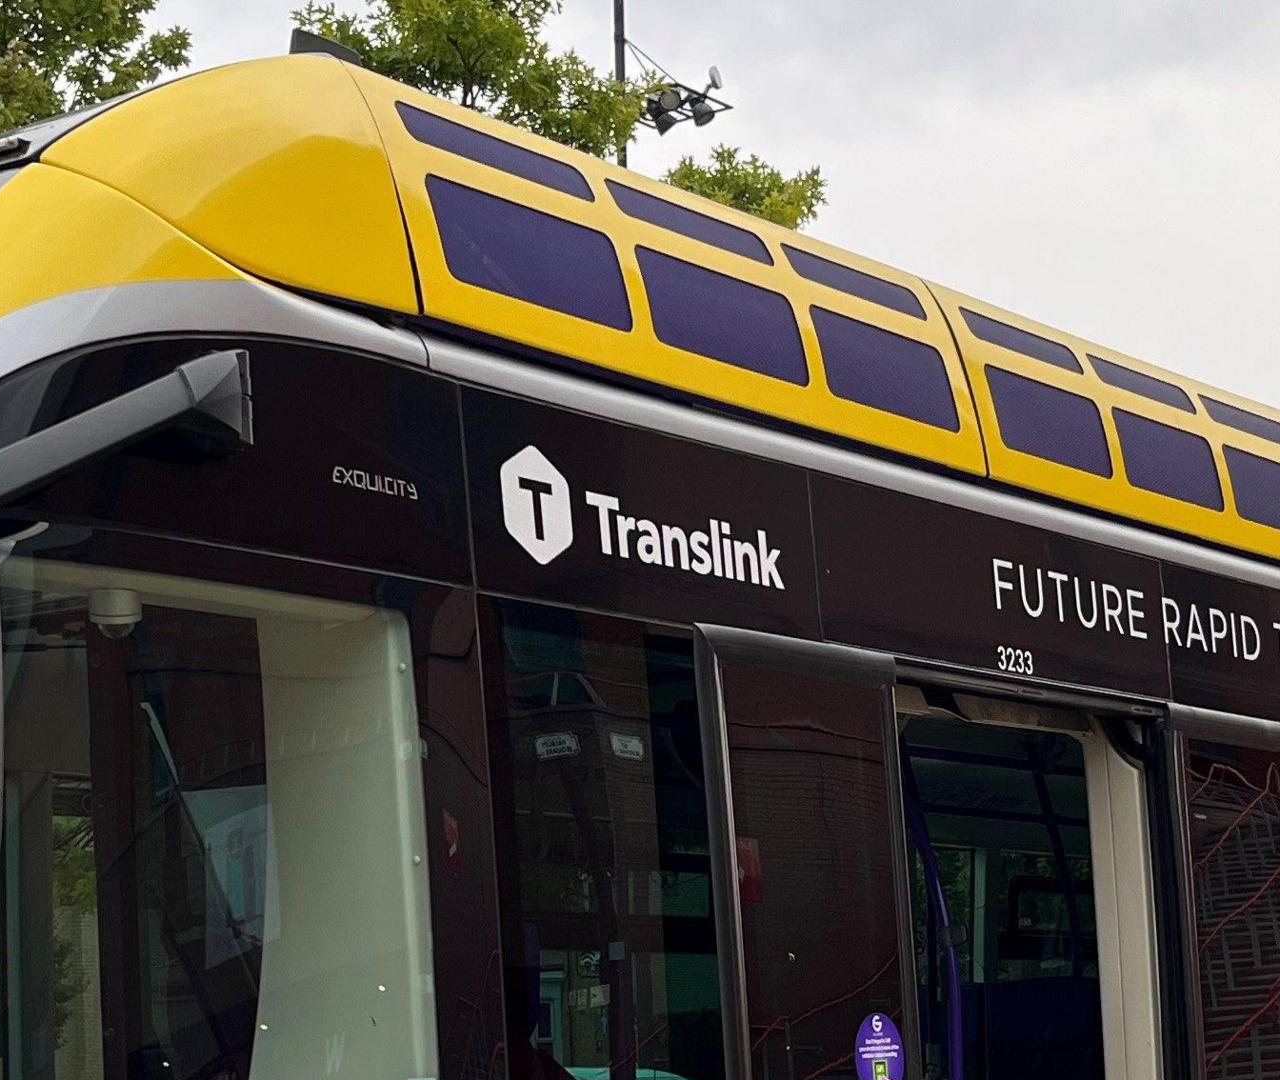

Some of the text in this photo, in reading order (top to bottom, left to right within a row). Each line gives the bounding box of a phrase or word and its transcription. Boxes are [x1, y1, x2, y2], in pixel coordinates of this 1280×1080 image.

[585, 490, 786, 590] Translink
[992, 558, 1148, 640] FUTURE
[1161, 596, 1261, 661] RAPID
[997, 645, 1034, 675] 3233
